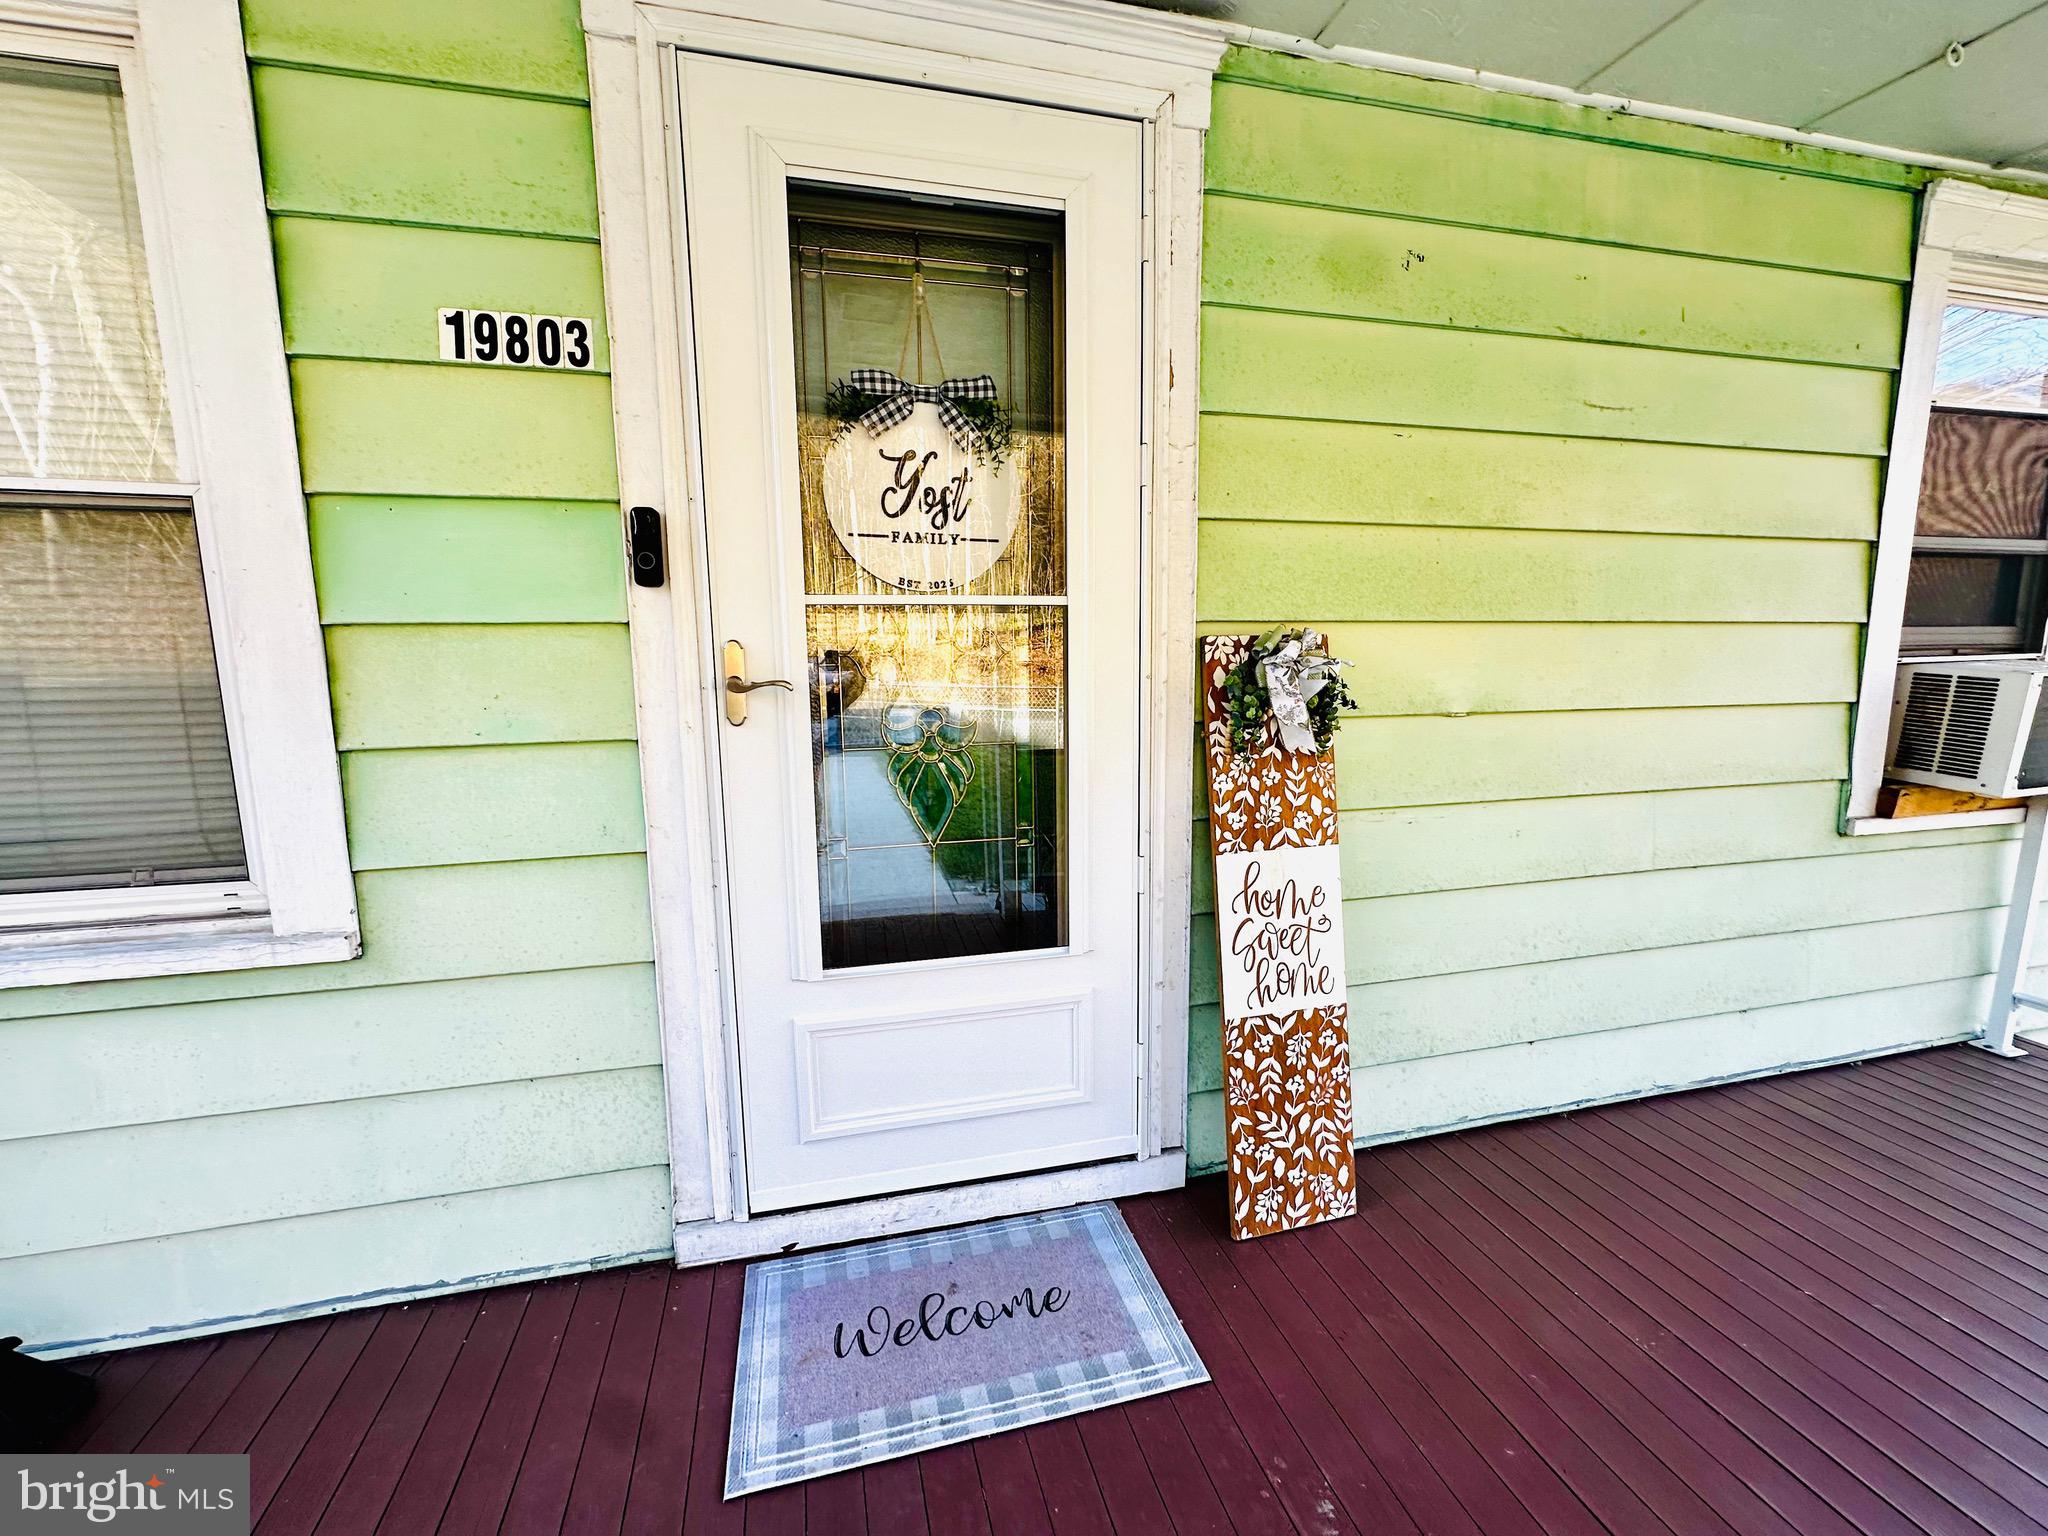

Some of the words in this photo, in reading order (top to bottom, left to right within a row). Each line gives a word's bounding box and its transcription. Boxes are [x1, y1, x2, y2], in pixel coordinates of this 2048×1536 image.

[445, 310, 591, 368] 19803
[878, 448, 973, 530] Yost
[890, 531, 960, 545] FAMILY
[898, 577, 921, 589] EST
[1232, 861, 1326, 919] home
[1247, 957, 1335, 1010] home
[833, 1286, 1071, 1358] Welcome
